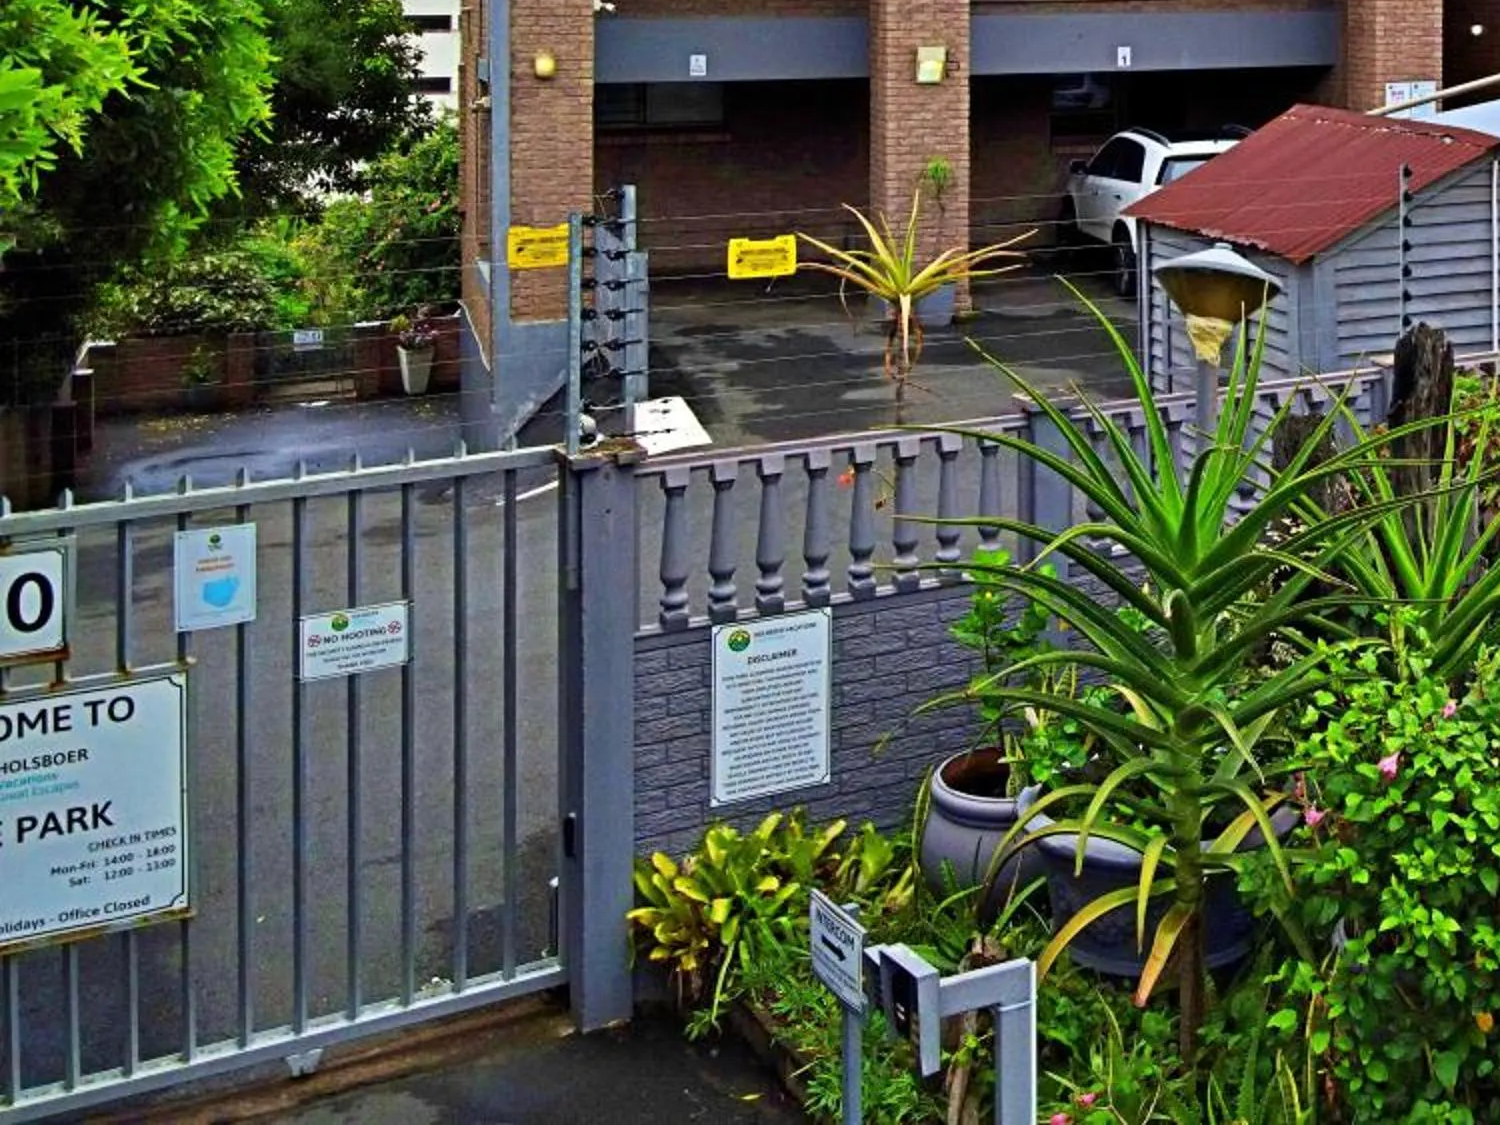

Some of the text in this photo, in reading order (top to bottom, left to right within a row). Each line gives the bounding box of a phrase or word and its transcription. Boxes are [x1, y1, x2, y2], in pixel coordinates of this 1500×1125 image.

[6, 571, 55, 634] 0
[323, 626, 387, 645] NO HOOTING
[747, 648, 798, 665] DISCLAIMER
[84, 695, 135, 727] TO
[16, 800, 115, 844] PARK
[87, 826, 177, 853] CHECK IN TIMES
[58, 907, 100, 924] Office
[103, 895, 151, 915] Closed
